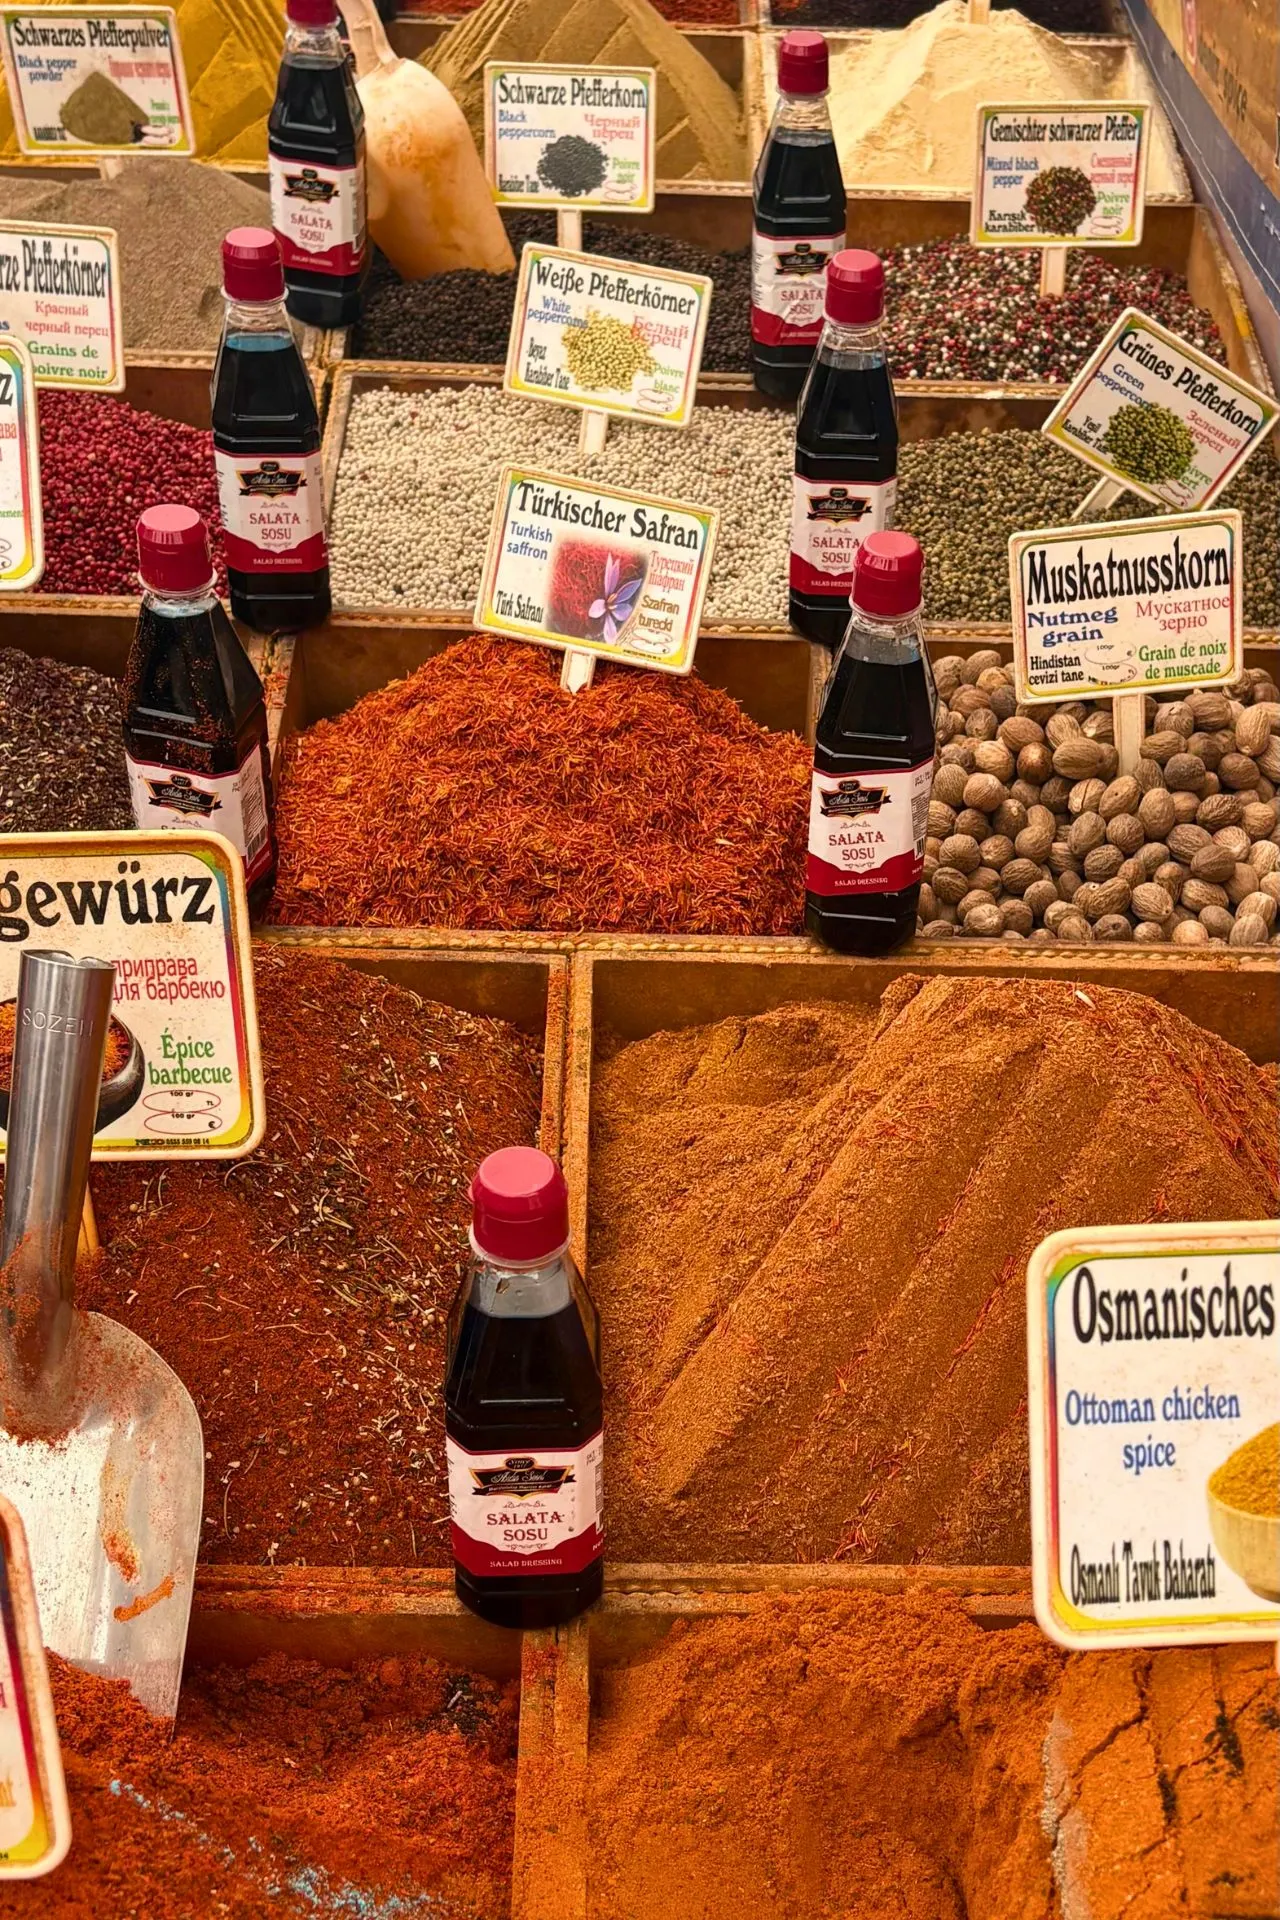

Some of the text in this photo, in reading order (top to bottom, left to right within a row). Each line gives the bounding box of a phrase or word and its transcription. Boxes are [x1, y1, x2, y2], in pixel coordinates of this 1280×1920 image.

[14, 18, 170, 52] Schwarzes Pfefferpulver
[18, 54, 77, 71] Black pepper
[29, 71, 63, 84] powder
[499, 74, 647, 108] Schwarze Pfefferkorn
[498, 109, 527, 123] Black
[990, 116, 1047, 142] Gemischter
[1049, 118, 1103, 142] schwarzer
[986, 156, 1039, 171] Mixed black
[992, 175, 1024, 188] pepper
[290, 213, 333, 230] SALATA
[300, 228, 325, 242] SOSU
[22, 239, 106, 298] Pfefferkörner
[536, 259, 696, 316] Weiße Pfefferkörner
[780, 290, 824, 302] SALATA
[35, 300, 88, 318] Красный
[542, 296, 572, 315] White
[25, 321, 70, 336] черный
[74, 326, 108, 339] перец
[27, 340, 98, 358] Grains de
[80, 365, 108, 379] noir
[1112, 364, 1146, 392] Green
[1118, 330, 1258, 436] Grünes Pfefferkorn
[1187, 410, 1242, 450] Зеленый
[249, 512, 301, 525] SALATA
[518, 480, 698, 550] Türkischer Safran
[261, 528, 292, 540] SOSU
[510, 520, 553, 544] Turkish
[812, 536, 860, 549] SALATA
[506, 540, 548, 561] saffron
[821, 552, 851, 564] SOSU
[1027, 536, 1230, 606] Muskatnusskorn
[496, 590, 514, 617] Türk
[641, 594, 680, 616] Szafran
[1135, 595, 1230, 620] Мускатное
[1028, 606, 1118, 628] Nutmeg
[1158, 614, 1208, 636] зерно
[1042, 626, 1104, 648] grain
[1138, 640, 1228, 662] Grain de noix
[1030, 654, 1081, 671] Hindistan
[1145, 663, 1160, 680] de
[1162, 658, 1221, 678] muscade
[1028, 669, 1058, 686] cevizi
[1061, 668, 1084, 682] tane
[828, 831, 885, 847] SALATA
[842, 848, 876, 861] SOSU
[0, 861, 216, 942] gewürz
[146, 973, 226, 1006] барбекю
[162, 1028, 216, 1060] Épice
[148, 1060, 232, 1085] barbecue
[1072, 1261, 1276, 1346] Osmanisches
[1065, 1384, 1241, 1426] Ottoman chicken
[1123, 1434, 1176, 1476] spice
[487, 1511, 563, 1526] SALATA
[504, 1528, 549, 1542] SOSU
[522, 1558, 562, 1567] DRESSING
[1070, 1540, 1216, 1606] Osmanlı Tavuk Baharatı
